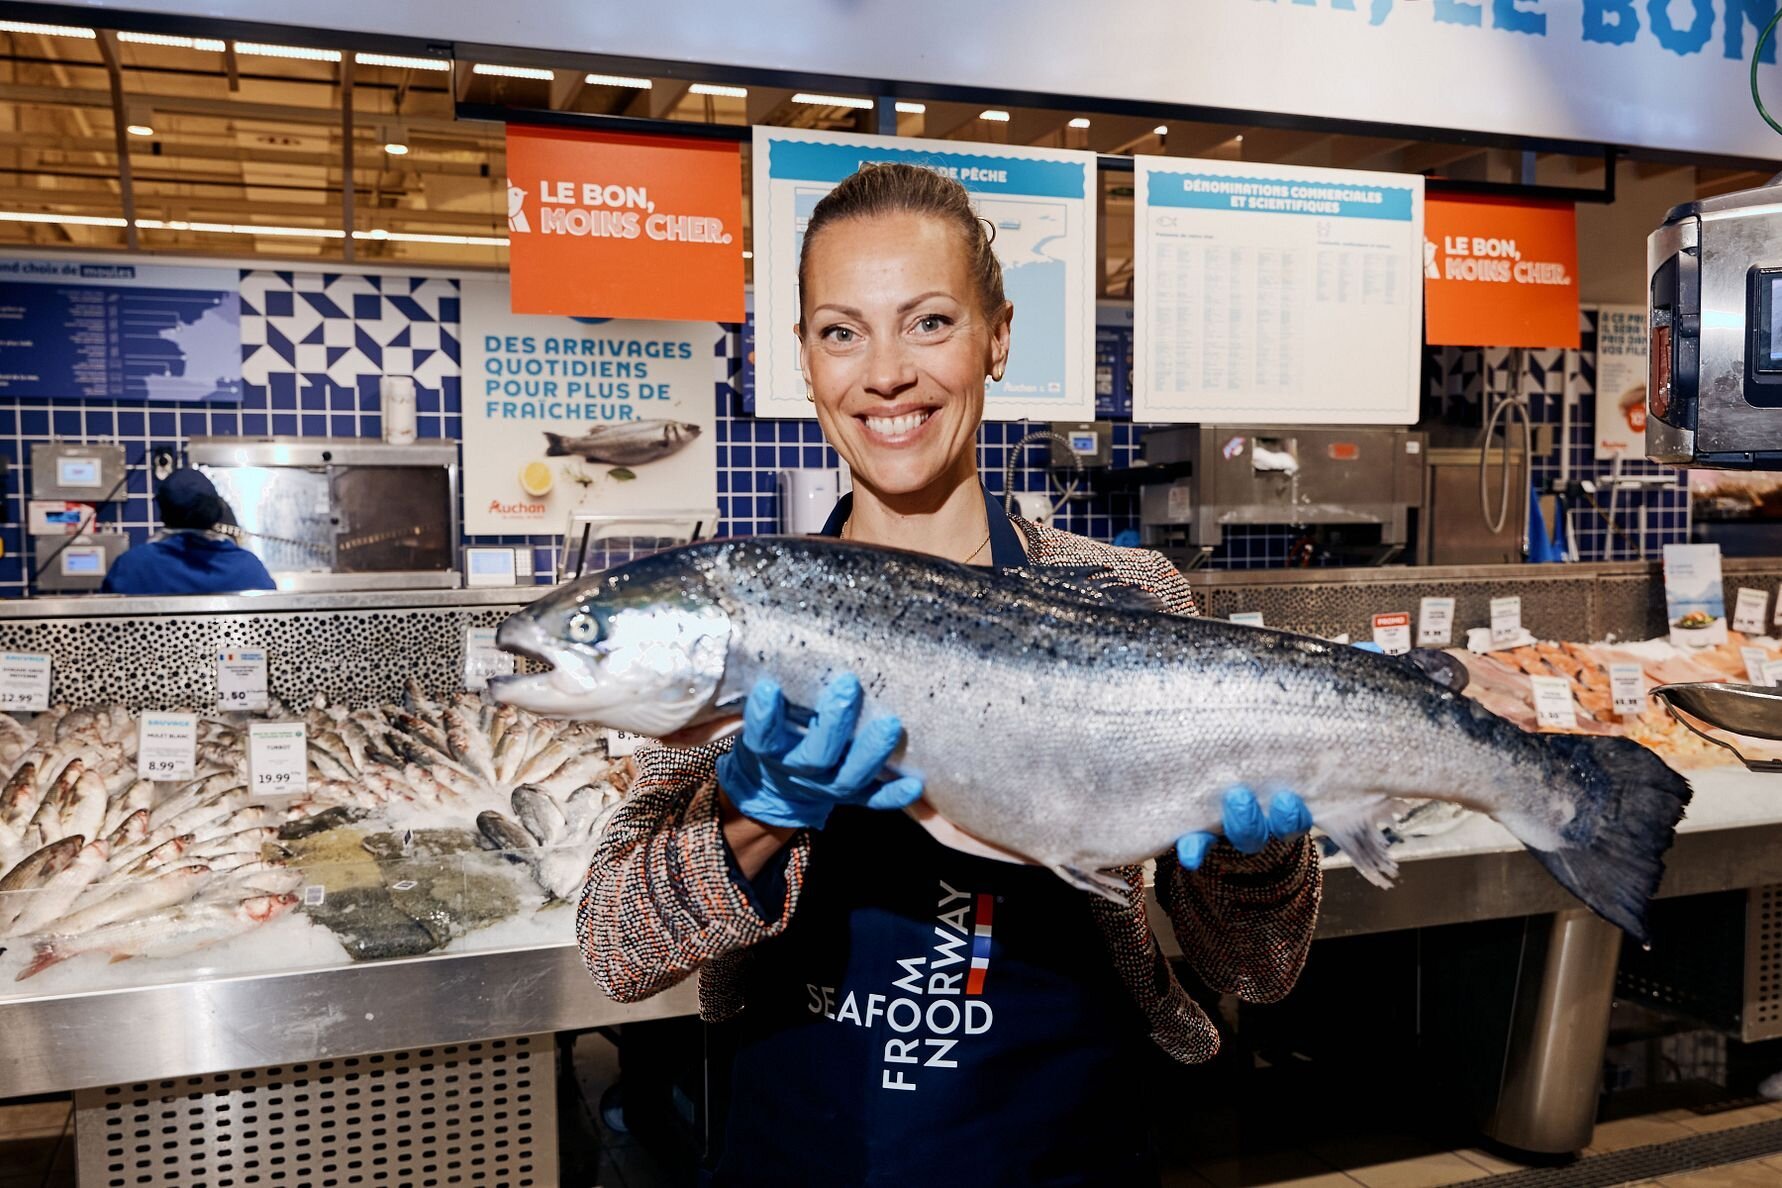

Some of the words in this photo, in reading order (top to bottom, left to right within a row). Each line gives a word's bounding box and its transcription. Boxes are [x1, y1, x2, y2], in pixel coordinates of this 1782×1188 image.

[961, 166, 1007, 183] PÊCHE
[540, 180, 576, 204] LE
[582, 182, 655, 214] BON,
[1183, 178, 1288, 198] DÉNOMINATIONS
[1291, 186, 1383, 204] COMMERCIALES
[1230, 195, 1246, 208] ET
[1248, 197, 1340, 214] SCIENTIFIQUES
[541, 207, 640, 240] MOINS
[645, 213, 733, 245] CHER.
[1444, 235, 1469, 255] LE
[1472, 237, 1521, 261] BON,
[1445, 257, 1511, 283] MOINS
[1513, 261, 1571, 286] CHER.
[485, 336, 536, 354] DES
[544, 337, 692, 360] ARRIVAGES
[485, 358, 648, 379] QUOTIDIENS
[485, 380, 558, 398] POUR
[567, 382, 630, 399] PLUS
[639, 384, 671, 400] DE
[488, 500, 545, 513] Auchan
[148, 761, 175, 771] 8.99
[258, 773, 290, 784] 19.99
[806, 983, 993, 1035] SEAFOOD
